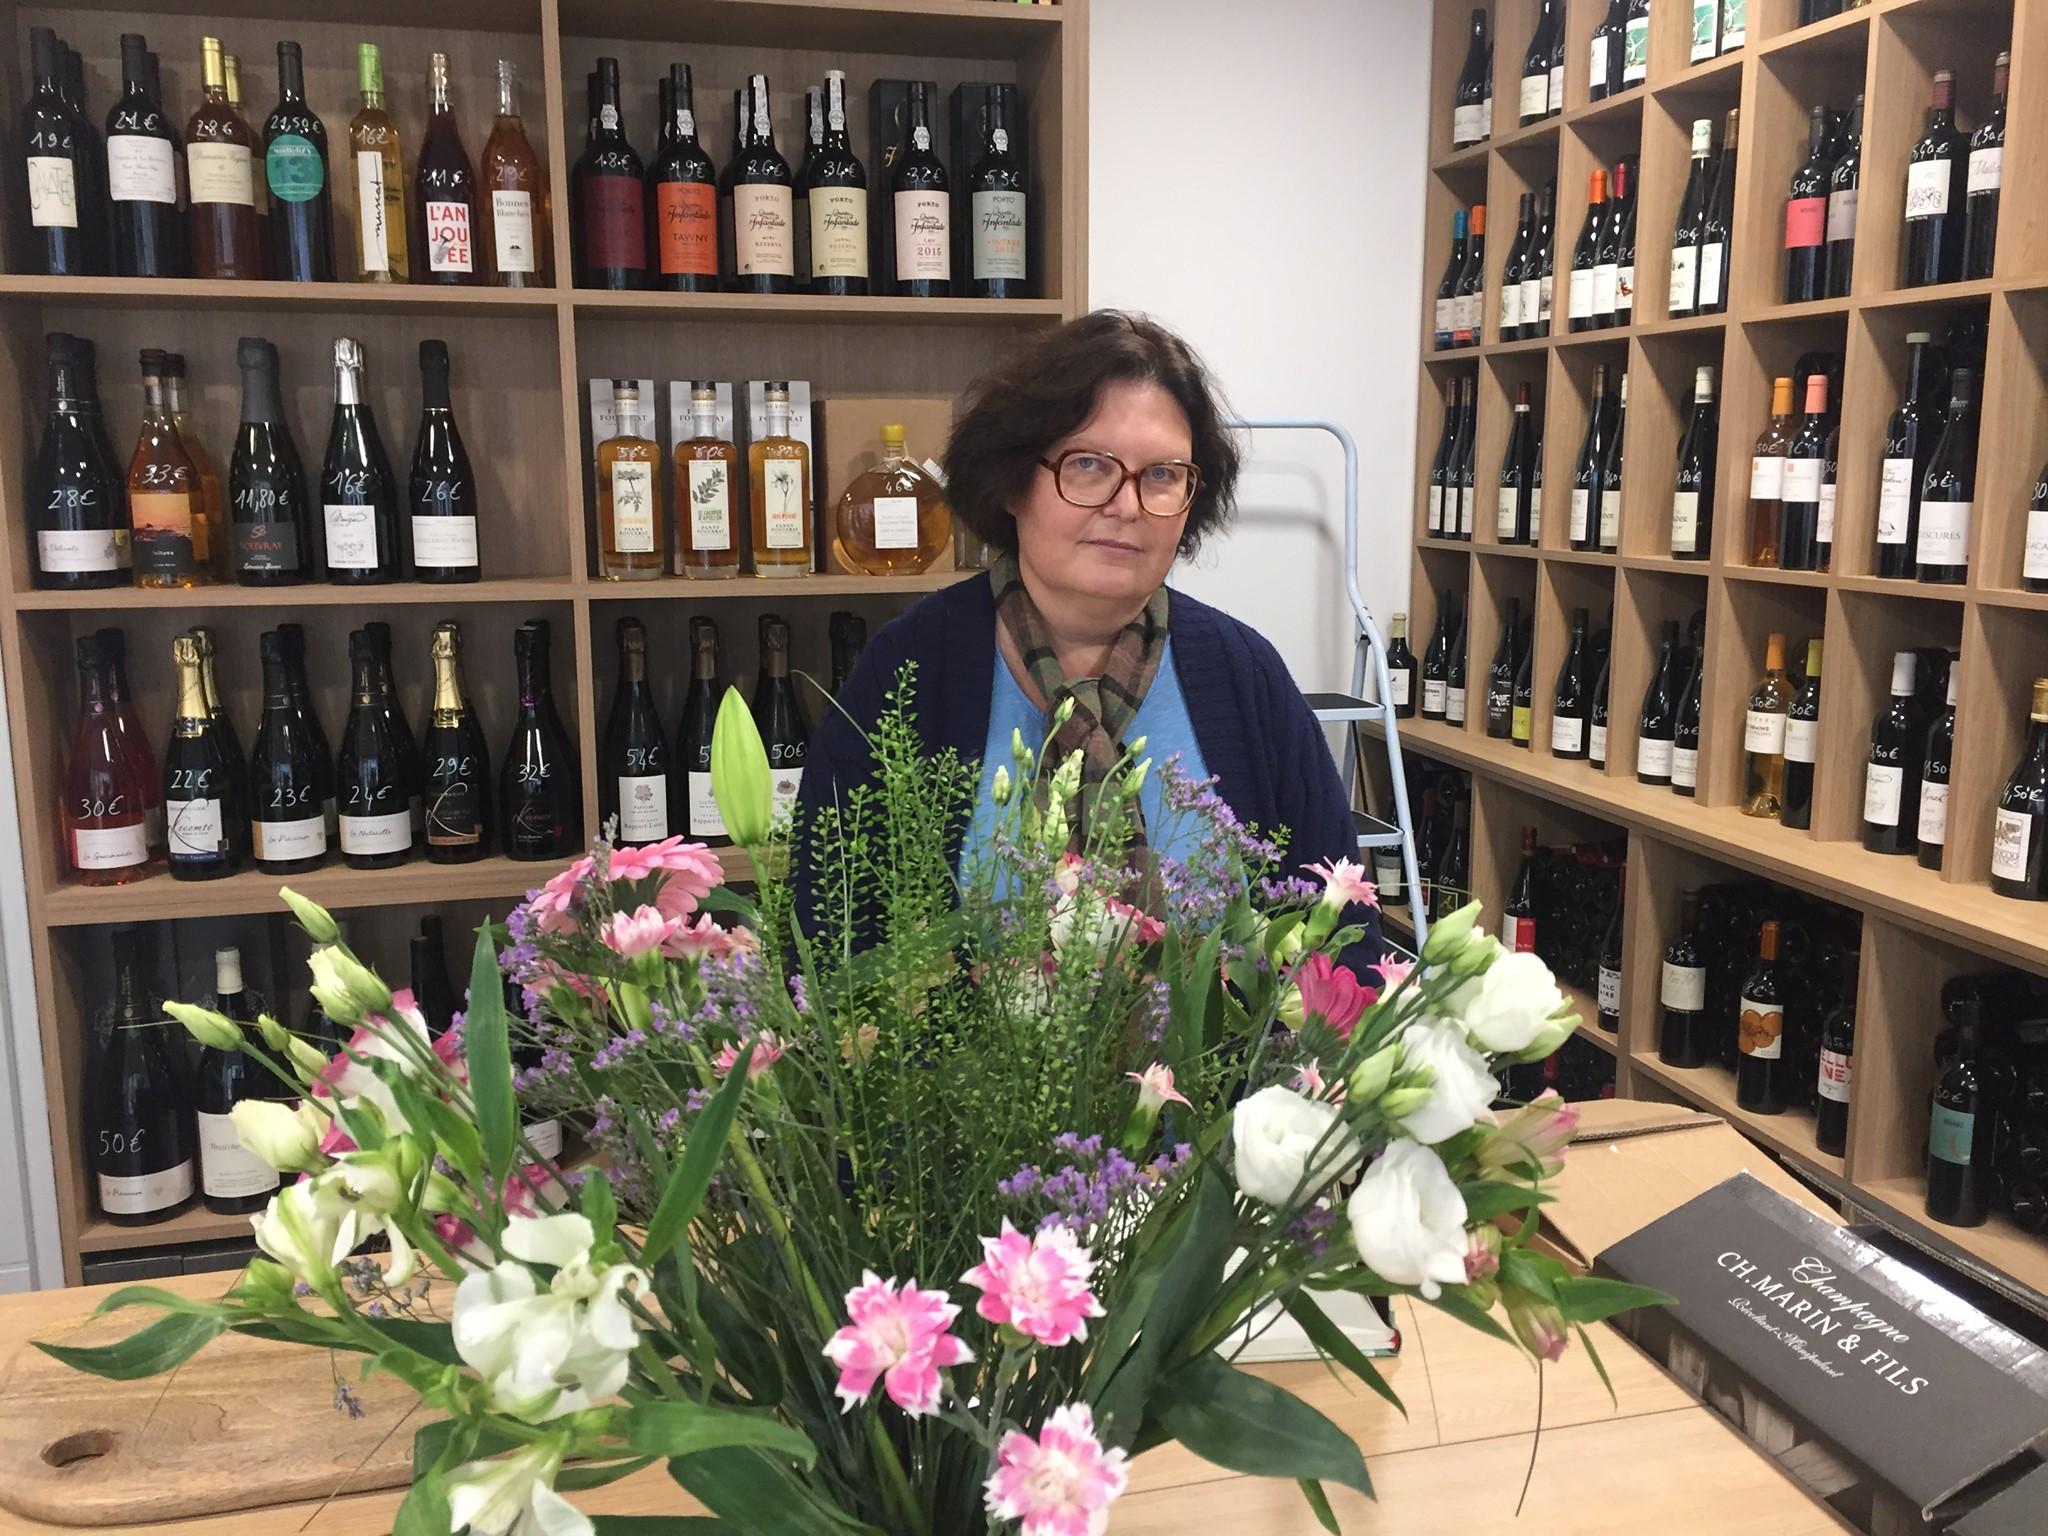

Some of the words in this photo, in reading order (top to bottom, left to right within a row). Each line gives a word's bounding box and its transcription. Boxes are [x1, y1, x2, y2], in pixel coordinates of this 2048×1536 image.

[114, 110, 160, 131] 21€
[594, 152, 630, 170] 18€
[909, 166, 942, 183] 32€
[430, 206, 466, 222] L'AN
[431, 226, 468, 243] JOU
[328, 471, 370, 495] 16€
[421, 480, 462, 503] 26€
[47, 489, 96, 509] 28€
[771, 742, 806, 760] 50€
[432, 757, 472, 777] 29€
[517, 763, 551, 783] 32€
[170, 769, 212, 789] 22€
[270, 785, 311, 808] 23€
[349, 785, 393, 811] 24€
[78, 795, 125, 819] 30€
[99, 1128, 146, 1156] 50€
[1788, 1256, 1911, 1344] Champagne
[1837, 1333, 1861, 1355] &
[1861, 1349, 1929, 1397] FILS
